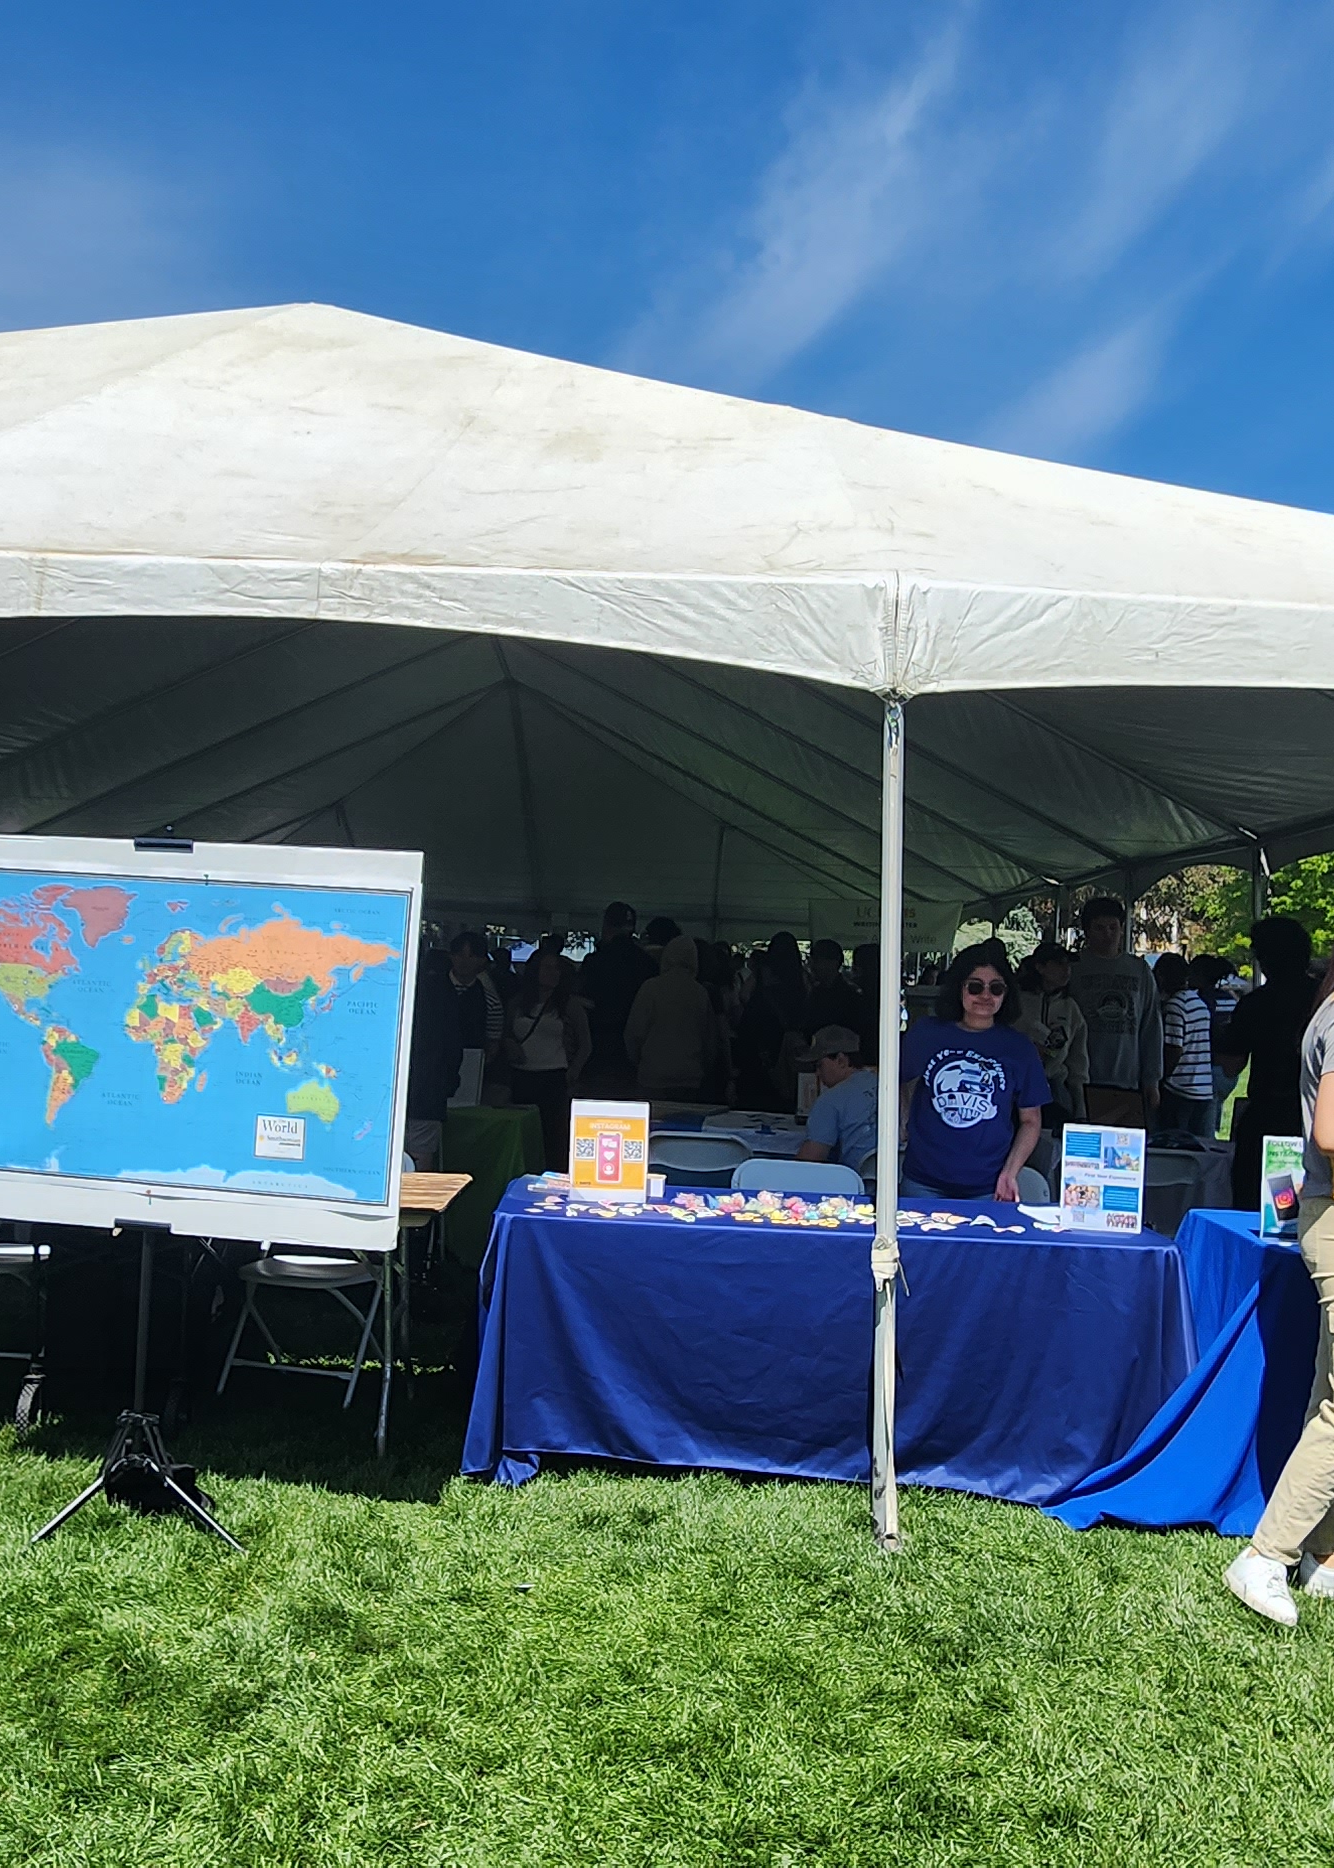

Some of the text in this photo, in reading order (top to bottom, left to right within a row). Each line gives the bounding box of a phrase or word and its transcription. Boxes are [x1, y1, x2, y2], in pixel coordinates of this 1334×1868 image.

[346, 1000, 379, 1009] PACIFIC
[262, 1119, 298, 1134] World
[589, 1122, 631, 1131] INSTAGRAM
